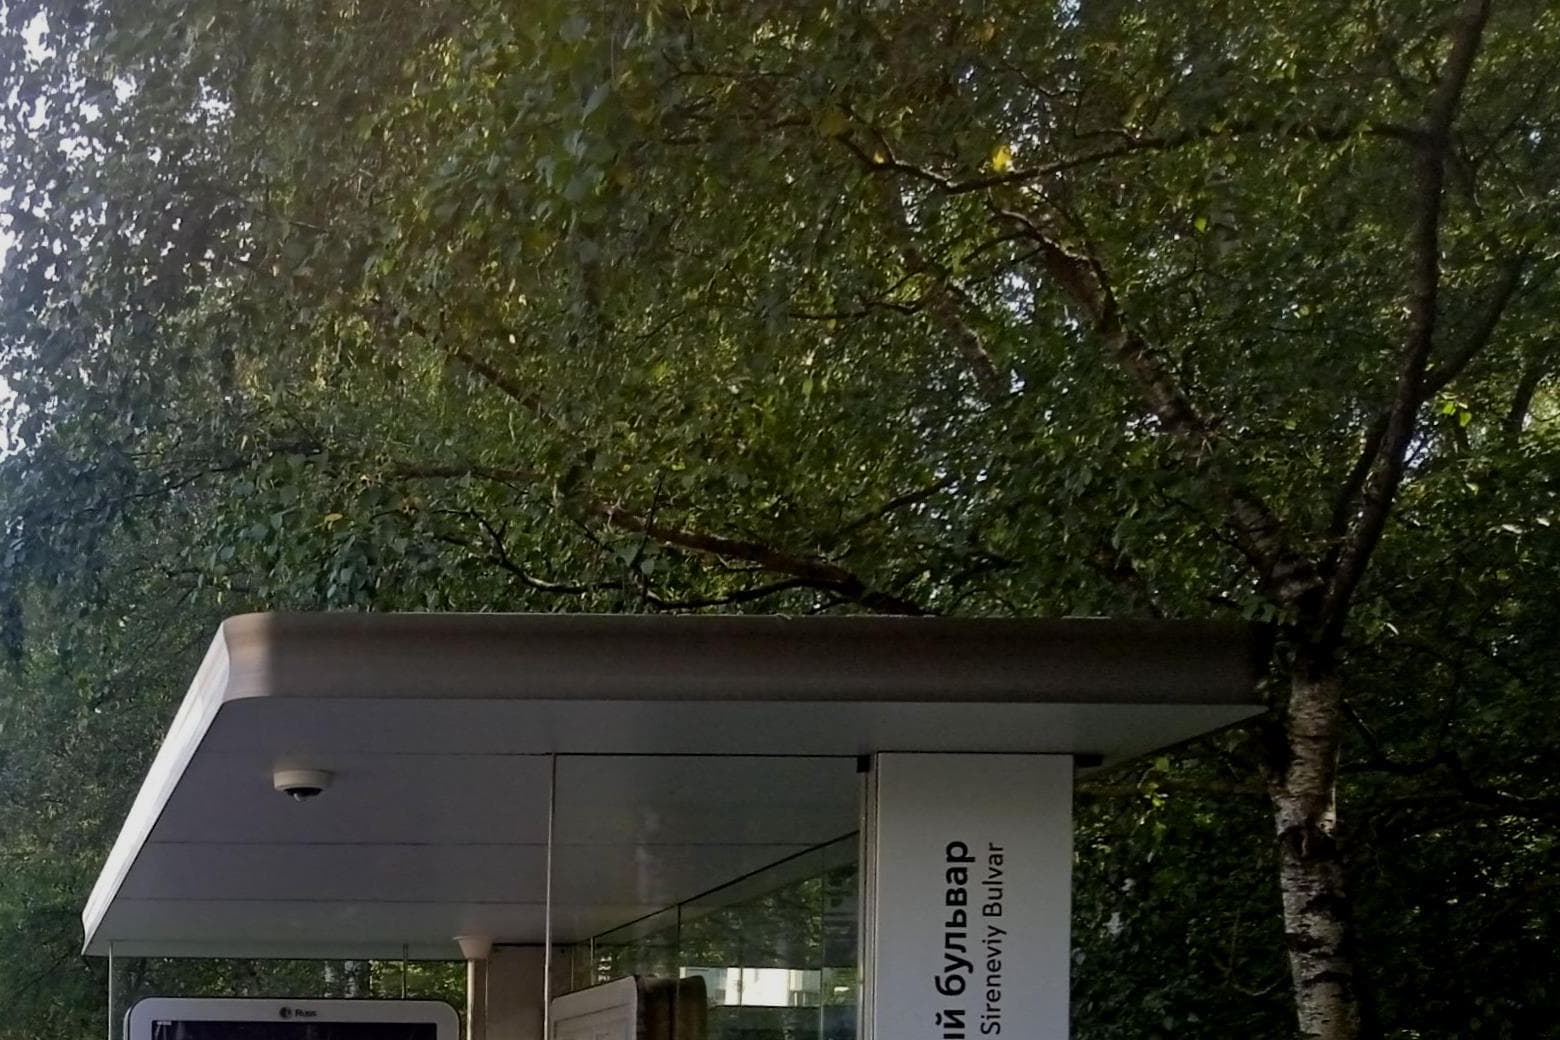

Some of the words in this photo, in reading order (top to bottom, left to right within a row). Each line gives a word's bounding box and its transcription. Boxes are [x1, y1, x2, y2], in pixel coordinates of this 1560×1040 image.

[934, 840, 976, 997] бульвар
[981, 841, 1005, 917] Bulvar
[980, 925, 1007, 1035] Sireneviy
